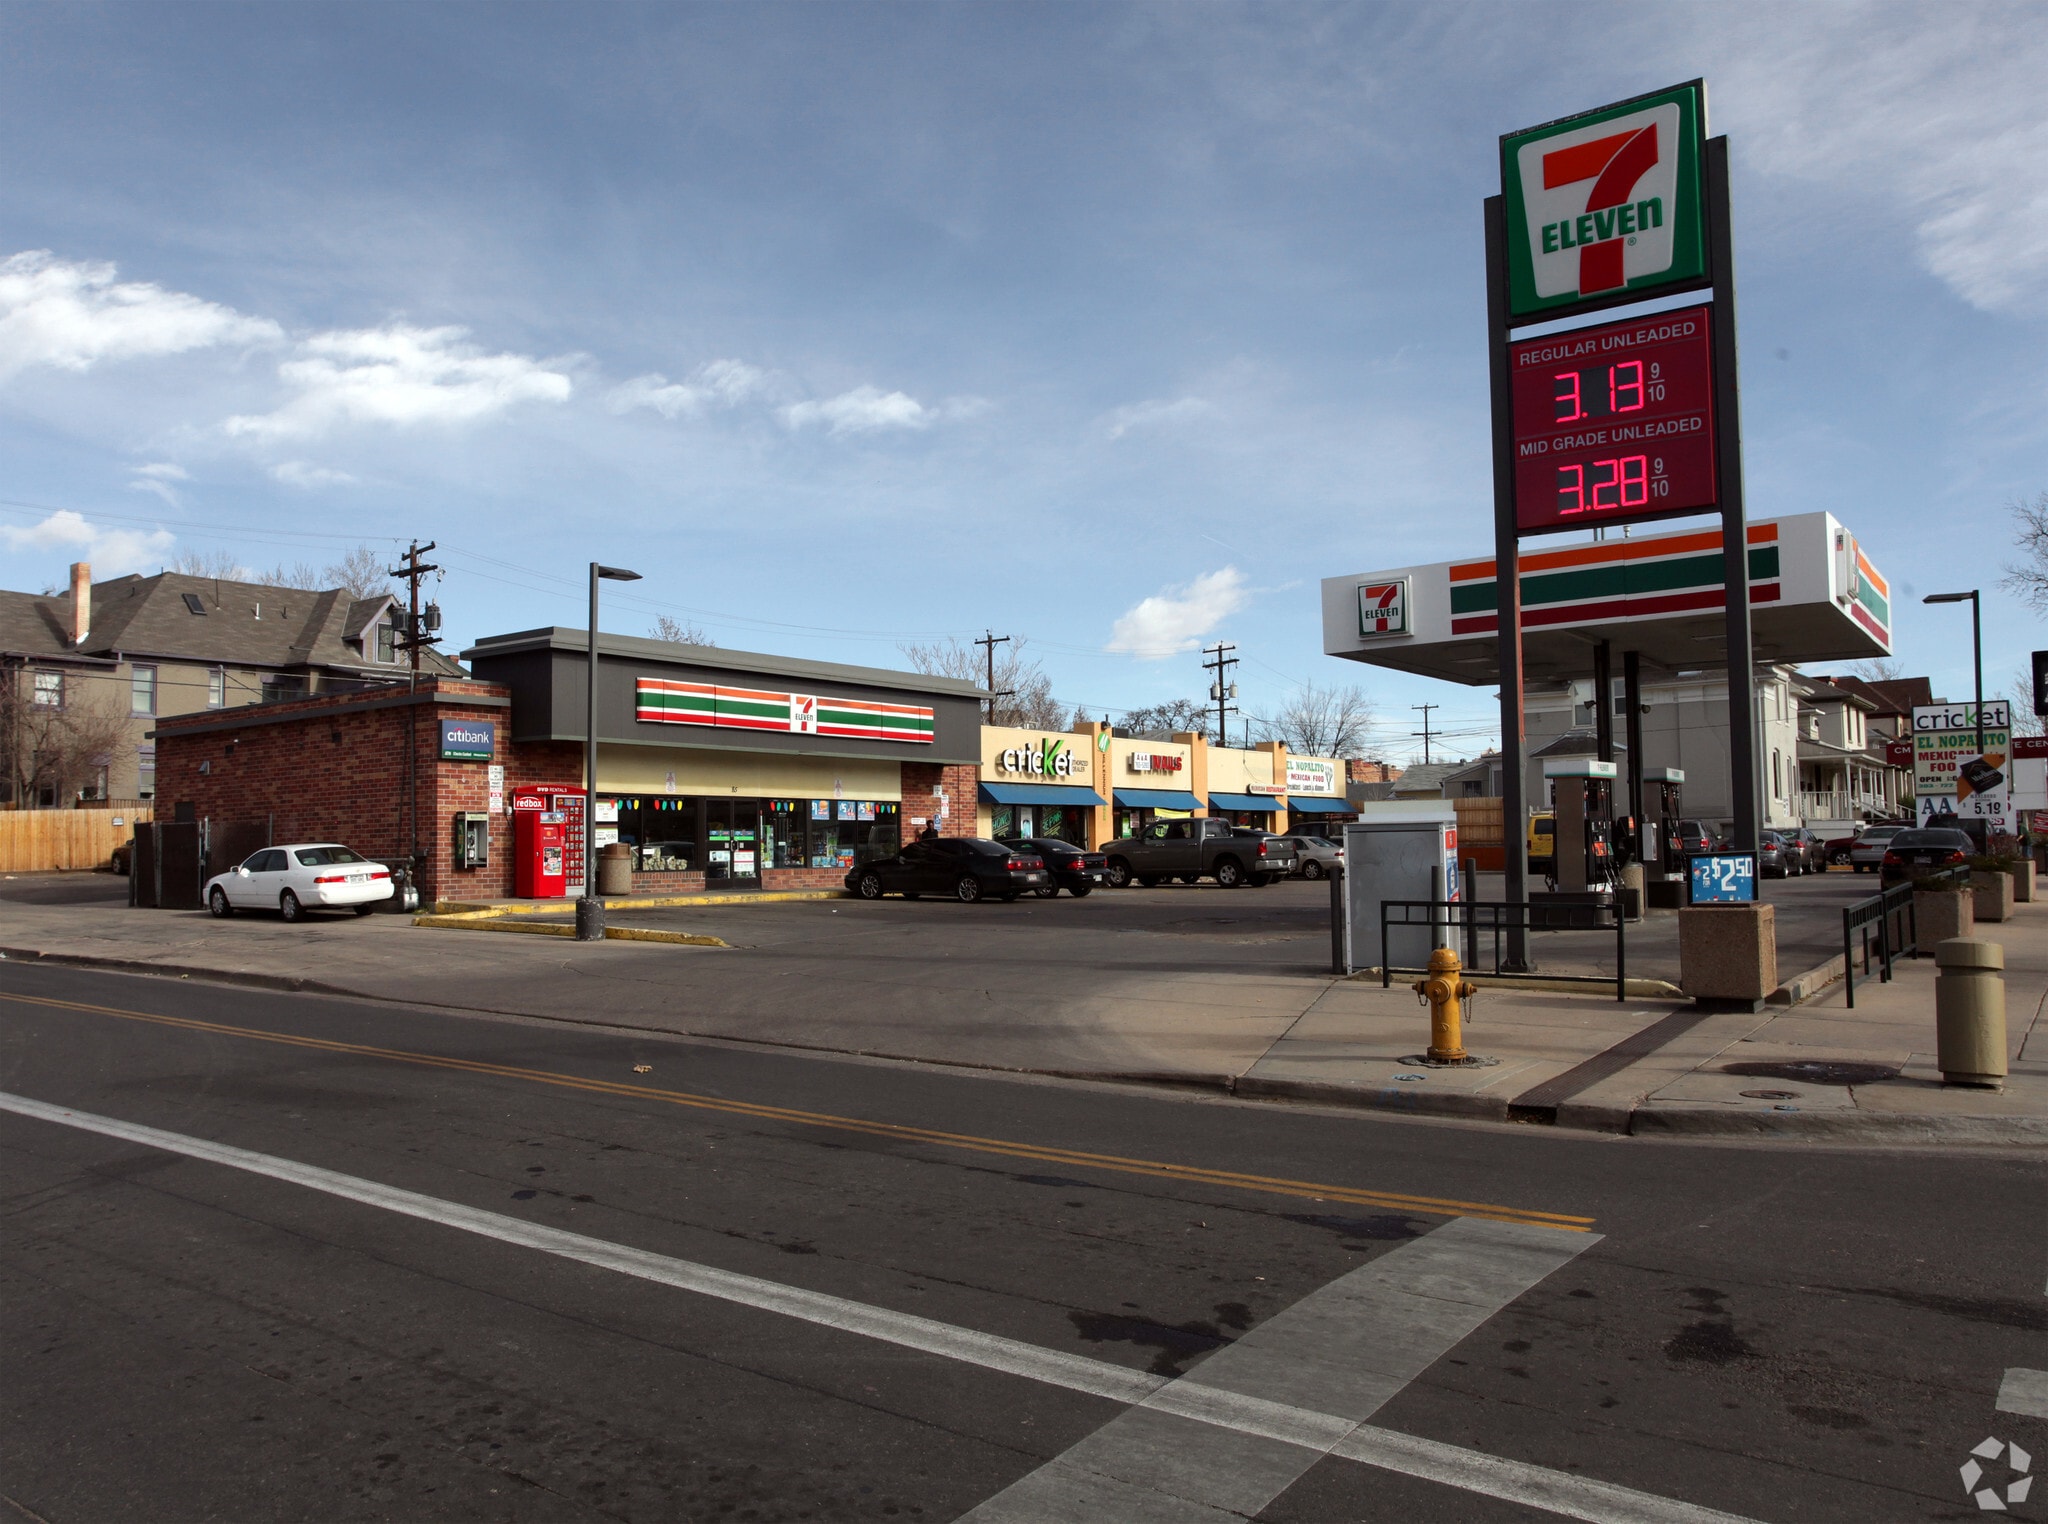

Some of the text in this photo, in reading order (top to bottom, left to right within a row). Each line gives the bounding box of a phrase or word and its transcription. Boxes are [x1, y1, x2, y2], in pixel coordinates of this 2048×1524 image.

[1542, 122, 1659, 297] 7
[1541, 195, 1664, 255] ELEVEn
[1518, 321, 1697, 366] REGULAR UNLEADED
[1555, 359, 1661, 424] 3.13 9
[1647, 384, 1666, 402] 10
[1519, 416, 1703, 457] MID GRADE UNLEADED
[1558, 454, 1664, 515] 3.28 9
[1650, 478, 1670, 498] 10
[1365, 584, 1398, 632] 7
[795, 696, 813, 732] 7
[447, 729, 490, 744] citibank
[1917, 732, 2007, 750] EL NOPAITO
[1152, 755, 1183, 771] NAILS
[1919, 775, 1942, 783] OPEN
[516, 796, 543, 808] redbox
[1974, 801, 2001, 815] 5.19
